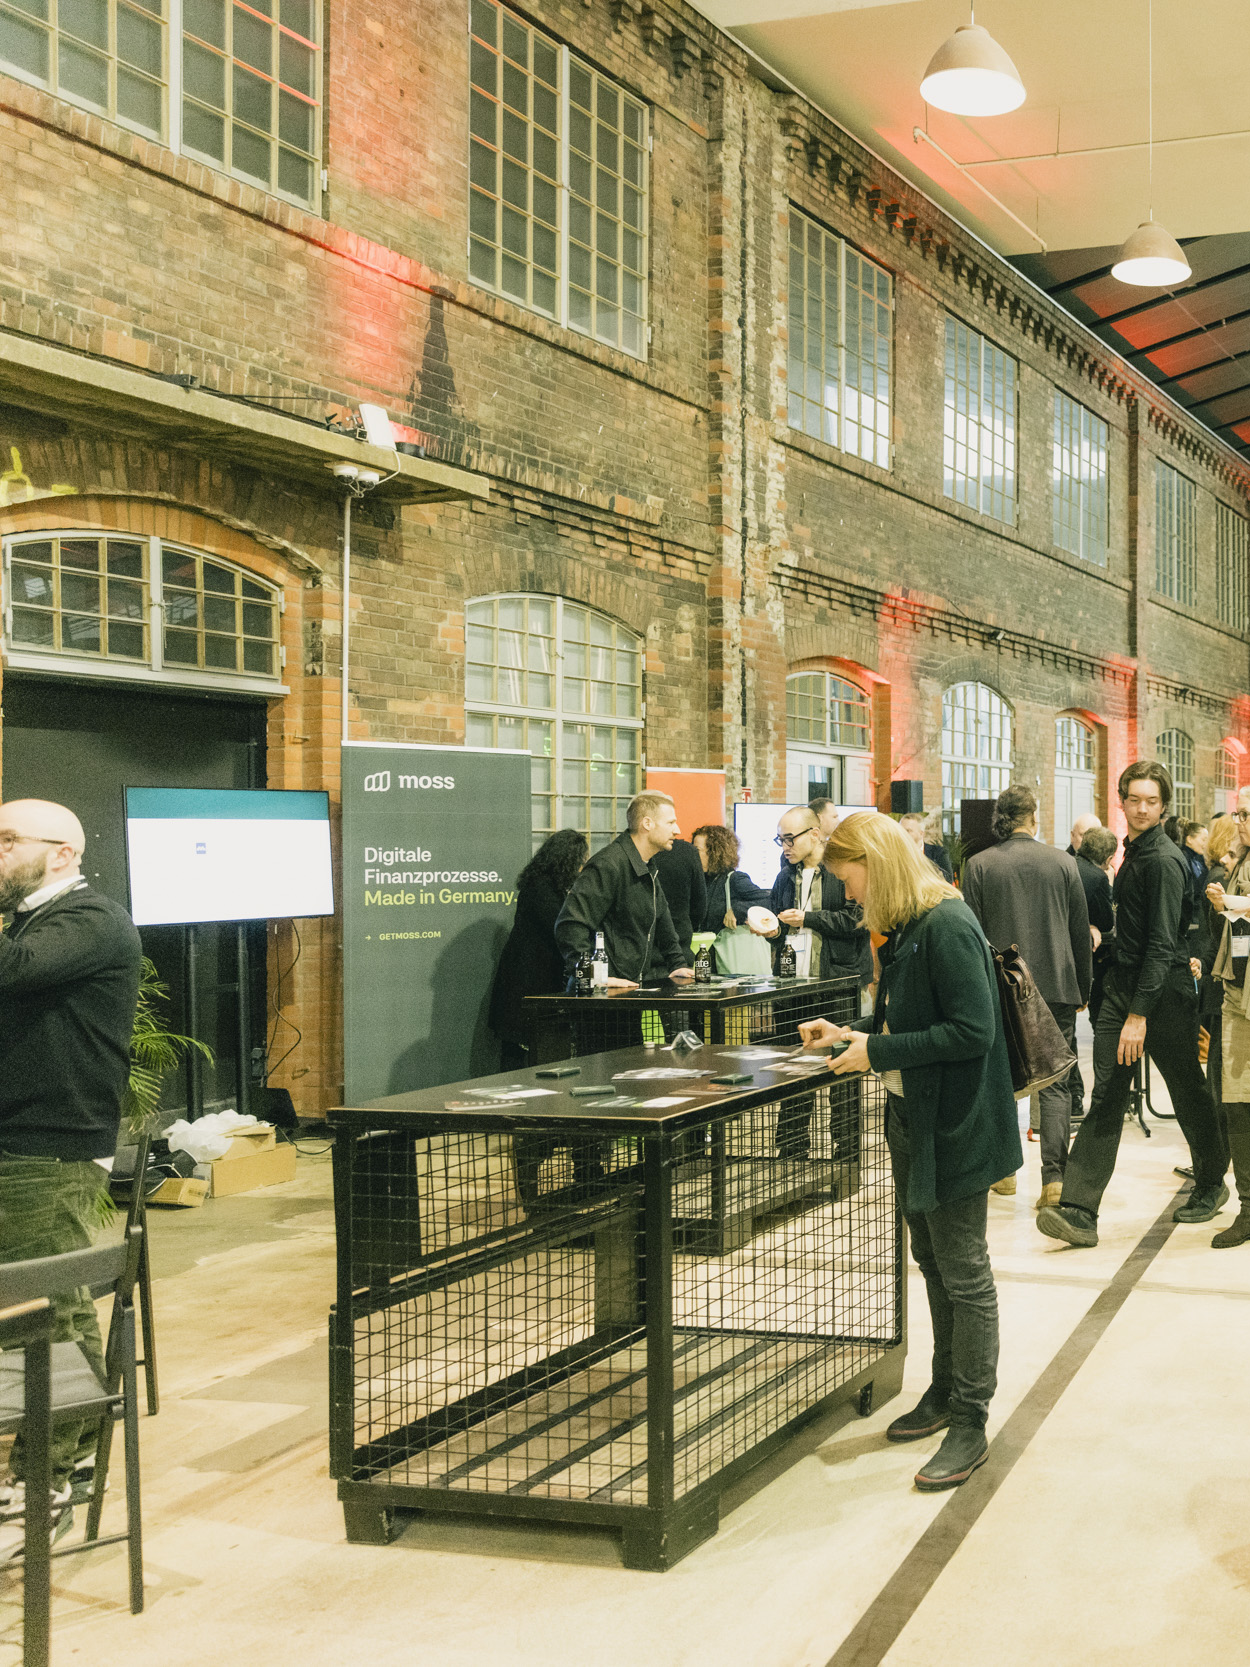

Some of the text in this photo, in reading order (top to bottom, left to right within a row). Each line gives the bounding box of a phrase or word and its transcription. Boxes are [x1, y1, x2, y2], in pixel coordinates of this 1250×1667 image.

[398, 774, 455, 790] moss
[364, 847, 432, 866] Digitale
[364, 868, 502, 886] Finanzprozesse.
[364, 888, 518, 907] Made in Germany.
[379, 931, 441, 940] GETMOSS.COM
